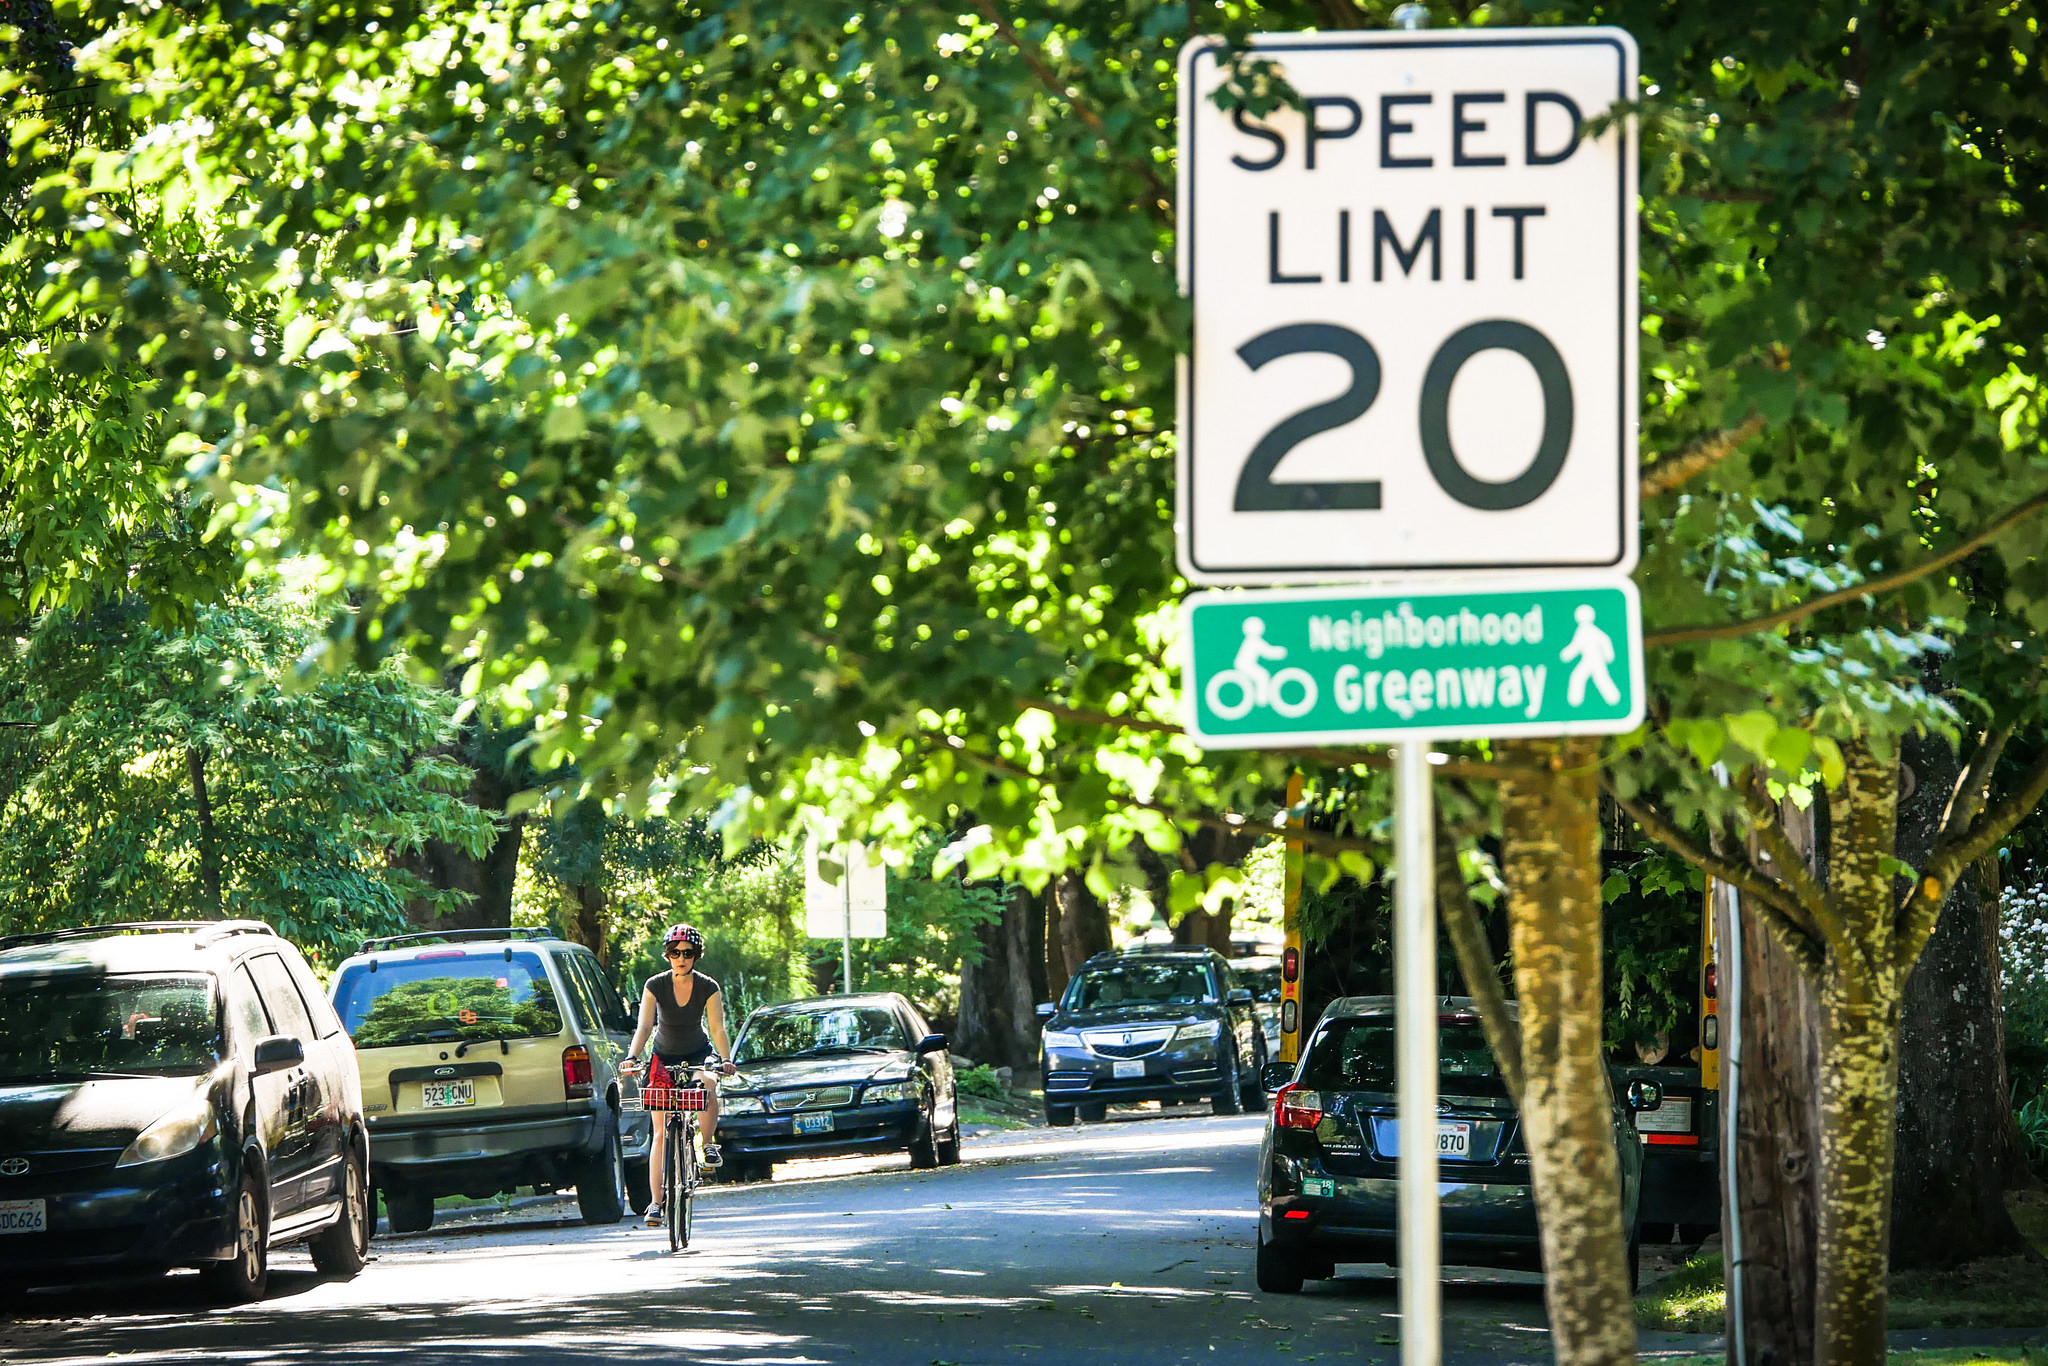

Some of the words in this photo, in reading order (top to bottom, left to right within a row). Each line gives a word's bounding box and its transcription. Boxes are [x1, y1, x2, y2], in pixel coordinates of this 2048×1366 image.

[1230, 91, 1585, 172] SPEED
[1268, 206, 1547, 285] LIMIT
[1232, 318, 1575, 512] 20
[1308, 603, 1544, 660] Neighborhood
[1333, 663, 1547, 719] Greenway
[424, 1087, 445, 1102] 523
[451, 1085, 472, 1099] CNU
[0, 1211, 42, 1229] DC626
